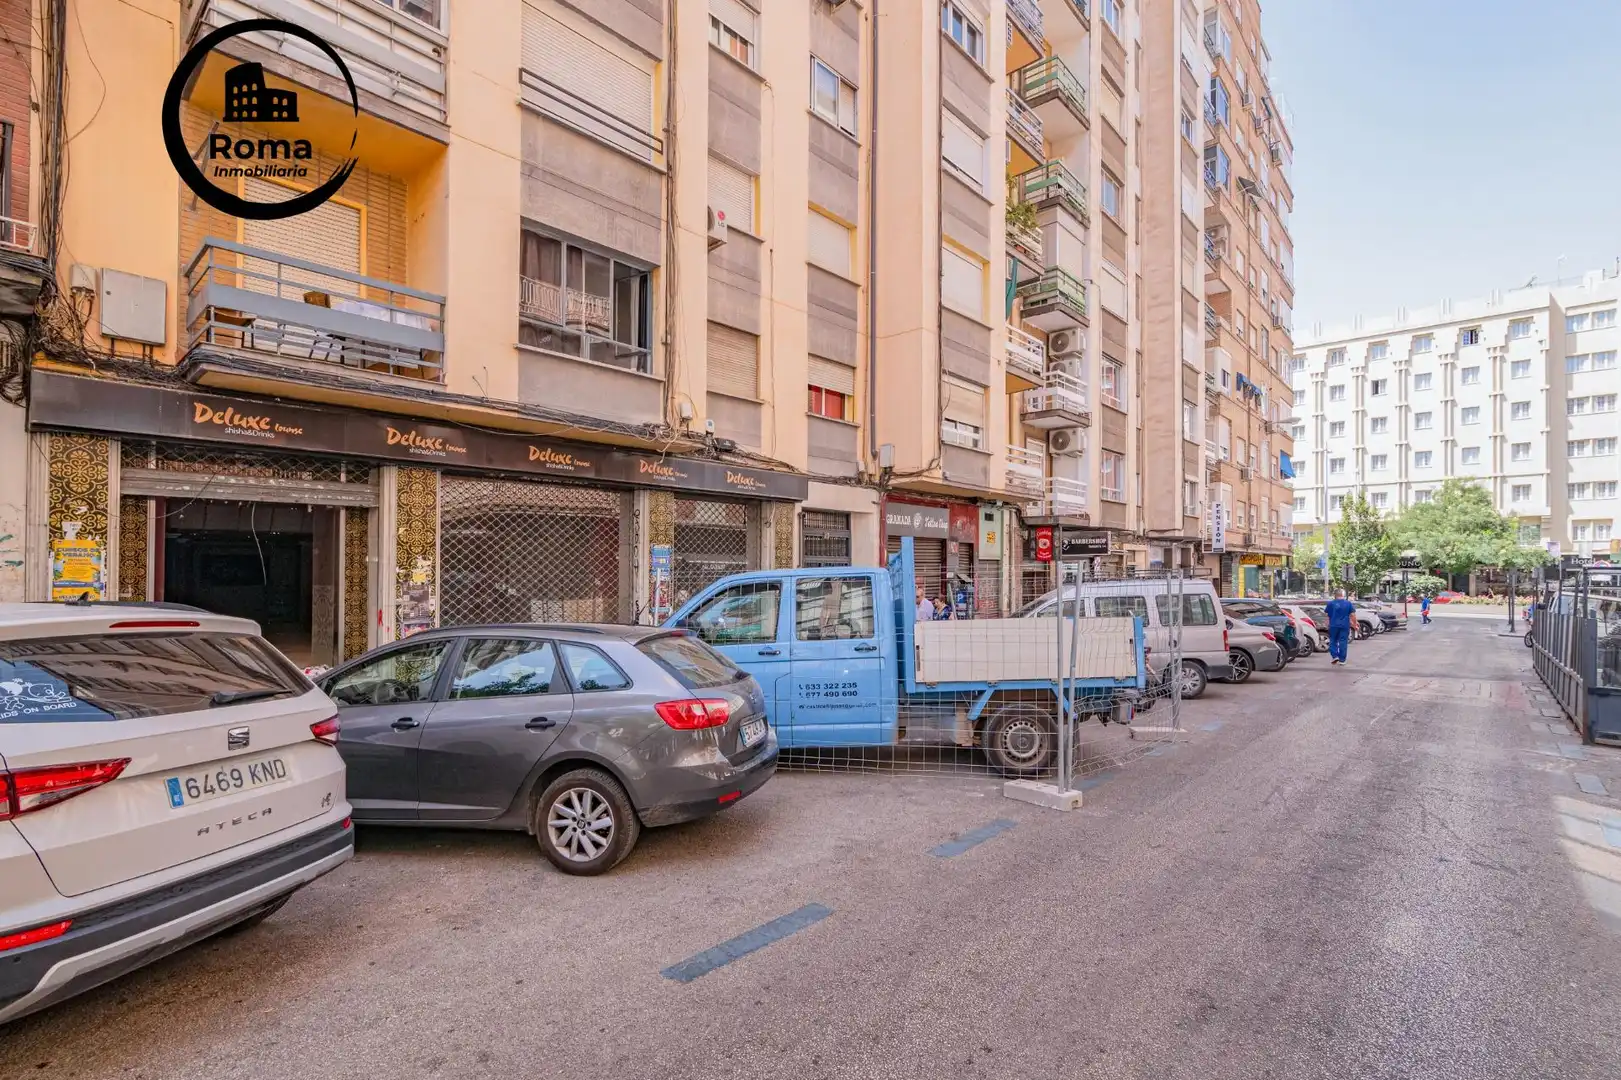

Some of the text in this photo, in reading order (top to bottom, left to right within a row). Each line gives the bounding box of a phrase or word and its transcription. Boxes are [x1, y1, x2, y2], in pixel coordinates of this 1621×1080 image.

[194, 402, 271, 430] Deluxe
[386, 426, 443, 450] Deluxe
[528, 445, 572, 465] Deluxe
[640, 459, 673, 476] Deluxe
[726, 470, 755, 486] Deluxe
[823, 682, 840, 690] 322
[23, 706, 39, 715] ON
[43, 701, 77, 711] BOARD
[185, 759, 287, 799] 6469 KND
[197, 807, 272, 836] ATECA
